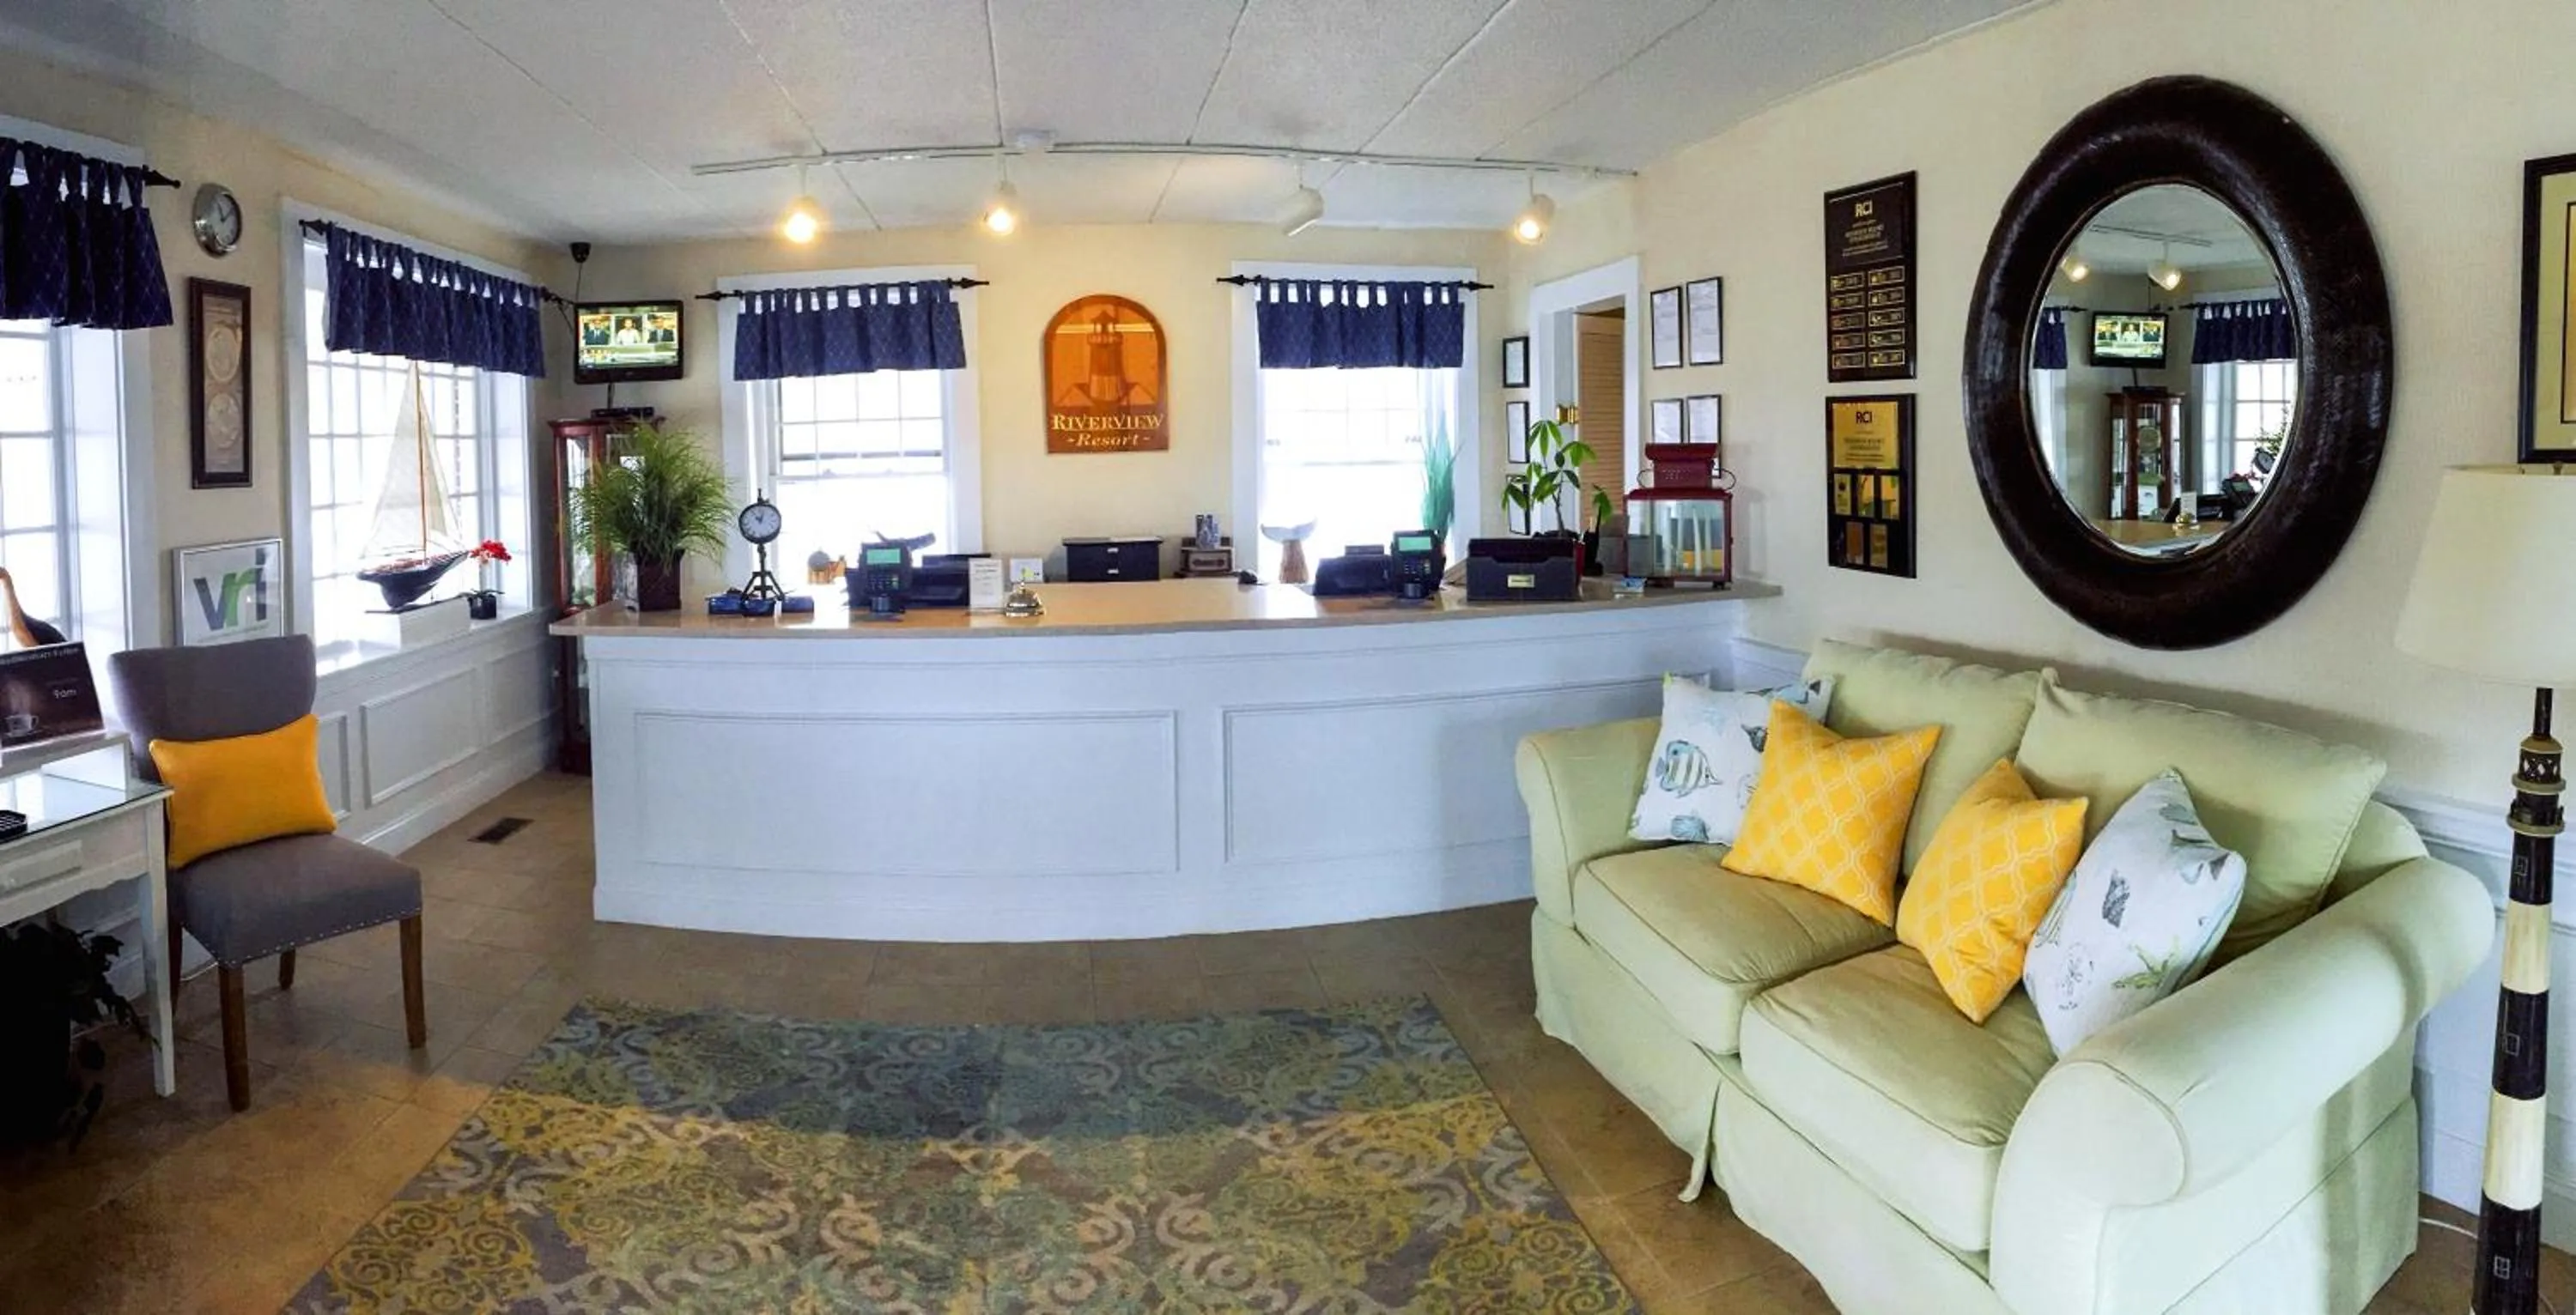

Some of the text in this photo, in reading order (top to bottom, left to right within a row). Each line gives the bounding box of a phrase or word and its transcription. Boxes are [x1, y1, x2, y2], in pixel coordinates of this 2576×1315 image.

[1855, 200, 1873, 217] RCI
[1052, 413, 1163, 431] RIVERVIEW
[1856, 411, 1873, 424] RCI
[193, 548, 267, 632] vri
